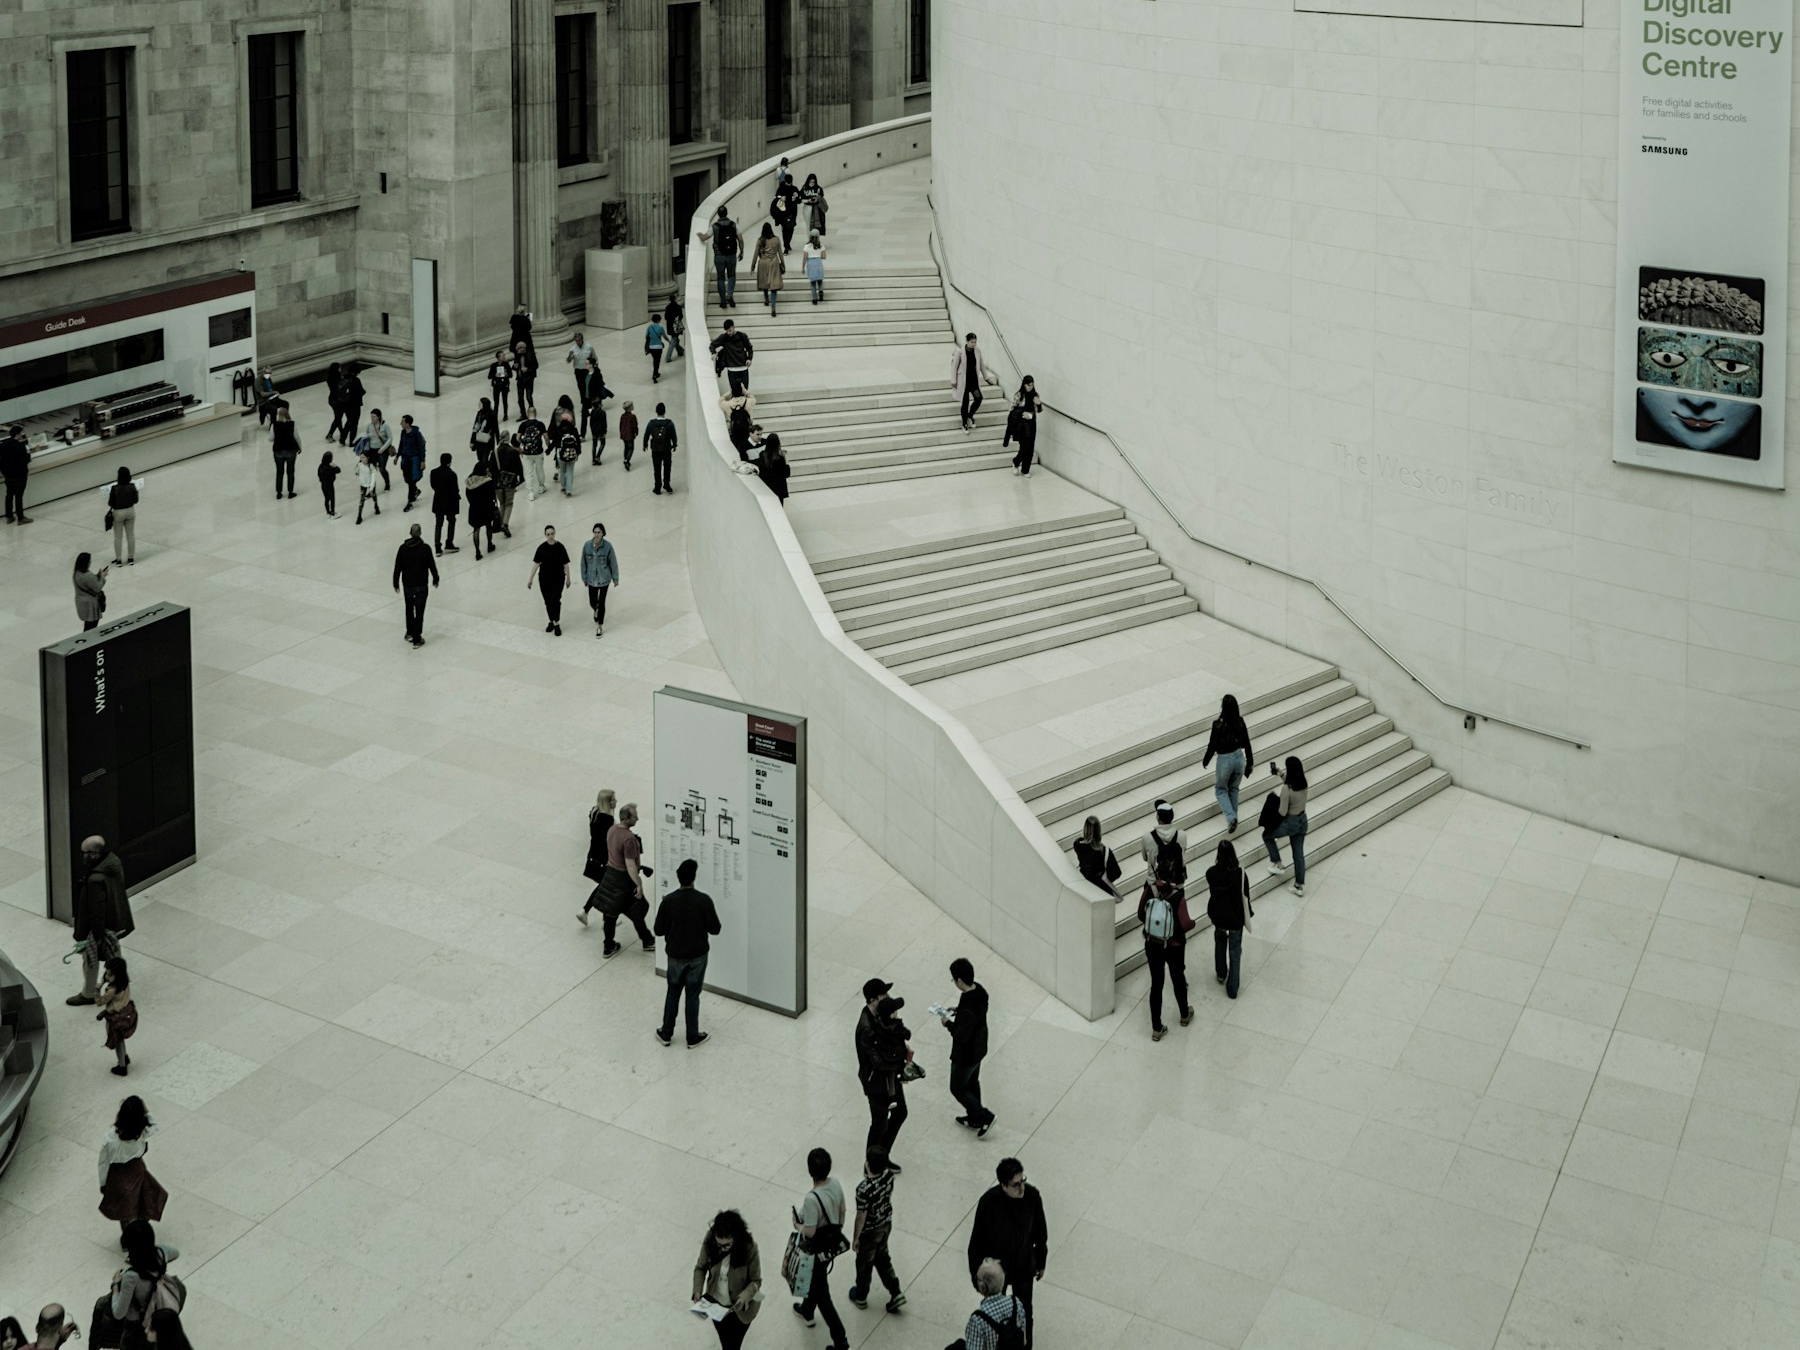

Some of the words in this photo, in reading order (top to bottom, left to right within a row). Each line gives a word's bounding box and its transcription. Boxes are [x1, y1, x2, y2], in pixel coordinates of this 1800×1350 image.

[1643, 20, 1783, 54] Discovery
[1642, 52, 1737, 79] Centre
[1642, 95, 1663, 106] Free
[1664, 97, 1692, 110] digital
[1694, 99, 1733, 111] activities
[1642, 107, 1655, 117] for
[1657, 108, 1691, 120] families
[1693, 111, 1710, 121] and
[1712, 112, 1748, 123] schools
[1641, 144, 1688, 156] SAMSUNG
[45, 321, 67, 332] Guide
[68, 316, 86, 326] Desk
[1330, 442, 1367, 475] The
[1376, 453, 1464, 497] Weston
[1475, 477, 1560, 526] Family
[96, 649, 105, 667] on
[94, 668, 106, 715] What's
